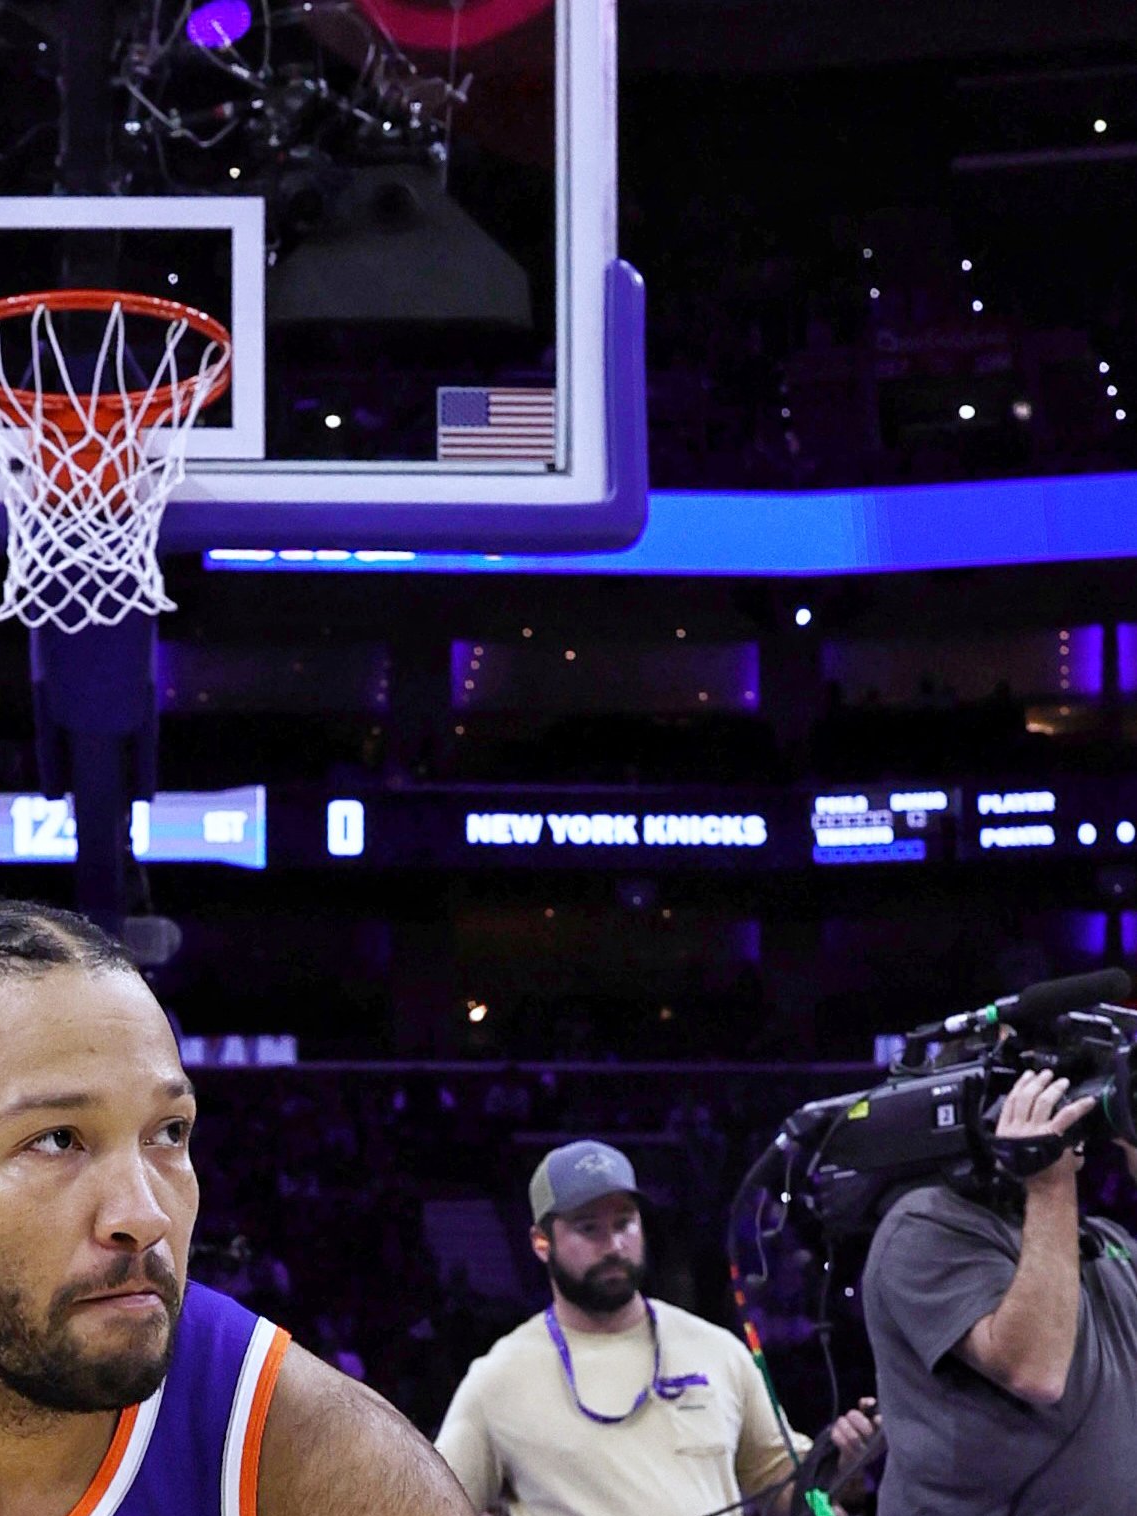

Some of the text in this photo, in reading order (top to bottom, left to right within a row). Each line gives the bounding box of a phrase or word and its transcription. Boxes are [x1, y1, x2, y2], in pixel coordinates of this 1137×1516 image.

[327, 800, 364, 856] 0
[466, 814, 767, 846] NEW YORK KNICKS
